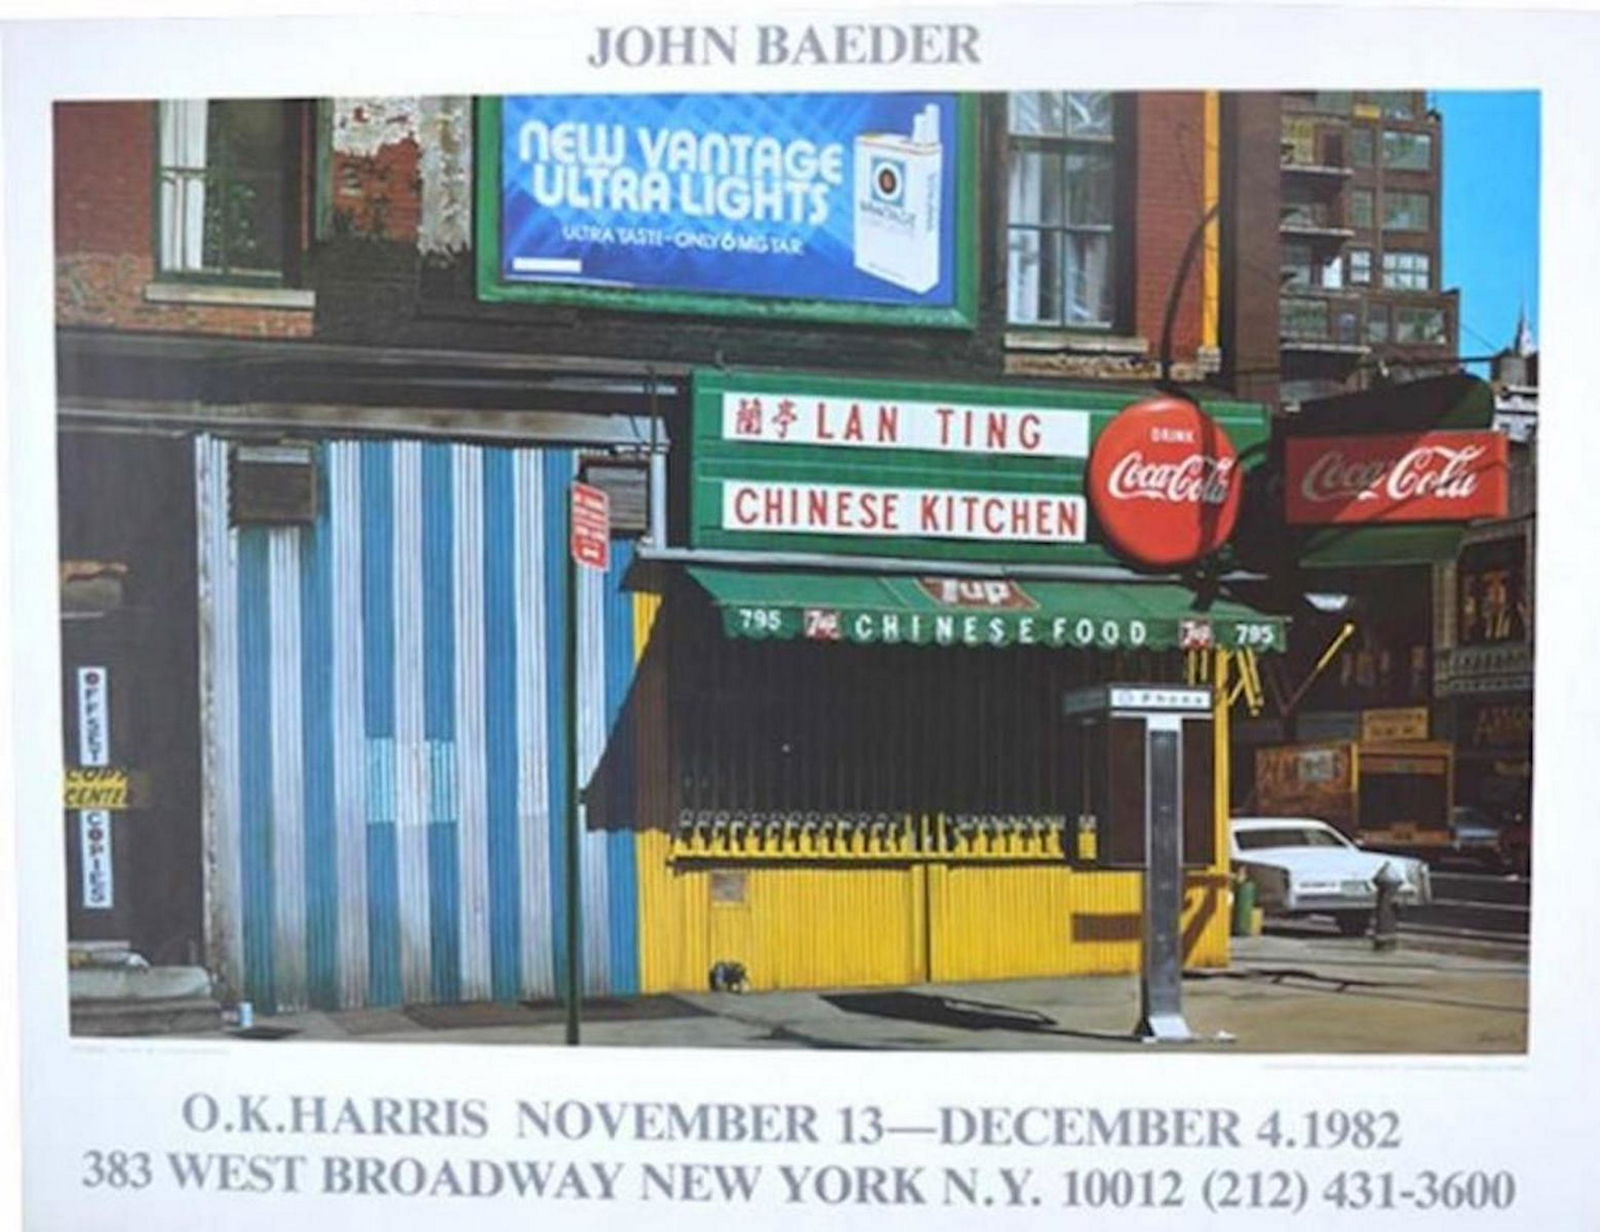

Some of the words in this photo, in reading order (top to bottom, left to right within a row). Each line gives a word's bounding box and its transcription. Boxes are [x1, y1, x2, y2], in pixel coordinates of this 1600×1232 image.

[587, 26, 737, 67] JOHN
[757, 24, 980, 65] BAEDER
[518, 120, 627, 166] NEW
[638, 127, 845, 185] VANTAGE
[533, 164, 671, 210] ULTRA
[681, 173, 831, 225] LIGHTS
[562, 225, 616, 244] ULTRA
[720, 231, 737, 252] 6
[816, 402, 898, 442] LAN
[936, 408, 1041, 449] TING
[734, 488, 899, 529] CHINESE
[921, 495, 1078, 536] KITCHEN
[738, 608, 782, 631] 795
[855, 613, 1035, 646] CHINESE
[1053, 617, 1147, 645] FOOD
[1235, 623, 1276, 645] 795
[182, 1094, 489, 1137] O.K.HARRIS
[518, 1101, 819, 1143] NOVEMBER
[1256, 1110, 1401, 1149] 4.1982
[82, 1150, 153, 1189] 383
[167, 1153, 306, 1193] WEST
[322, 1156, 623, 1200] BROADWAY
[641, 1163, 762, 1202] NEW
[779, 1165, 926, 1205] YORK
[943, 1167, 1041, 1207] N.Y.
[1062, 1169, 1184, 1208] 10012
[1201, 1170, 1309, 1212] (212)
[1323, 1170, 1516, 1210] 431-3600
